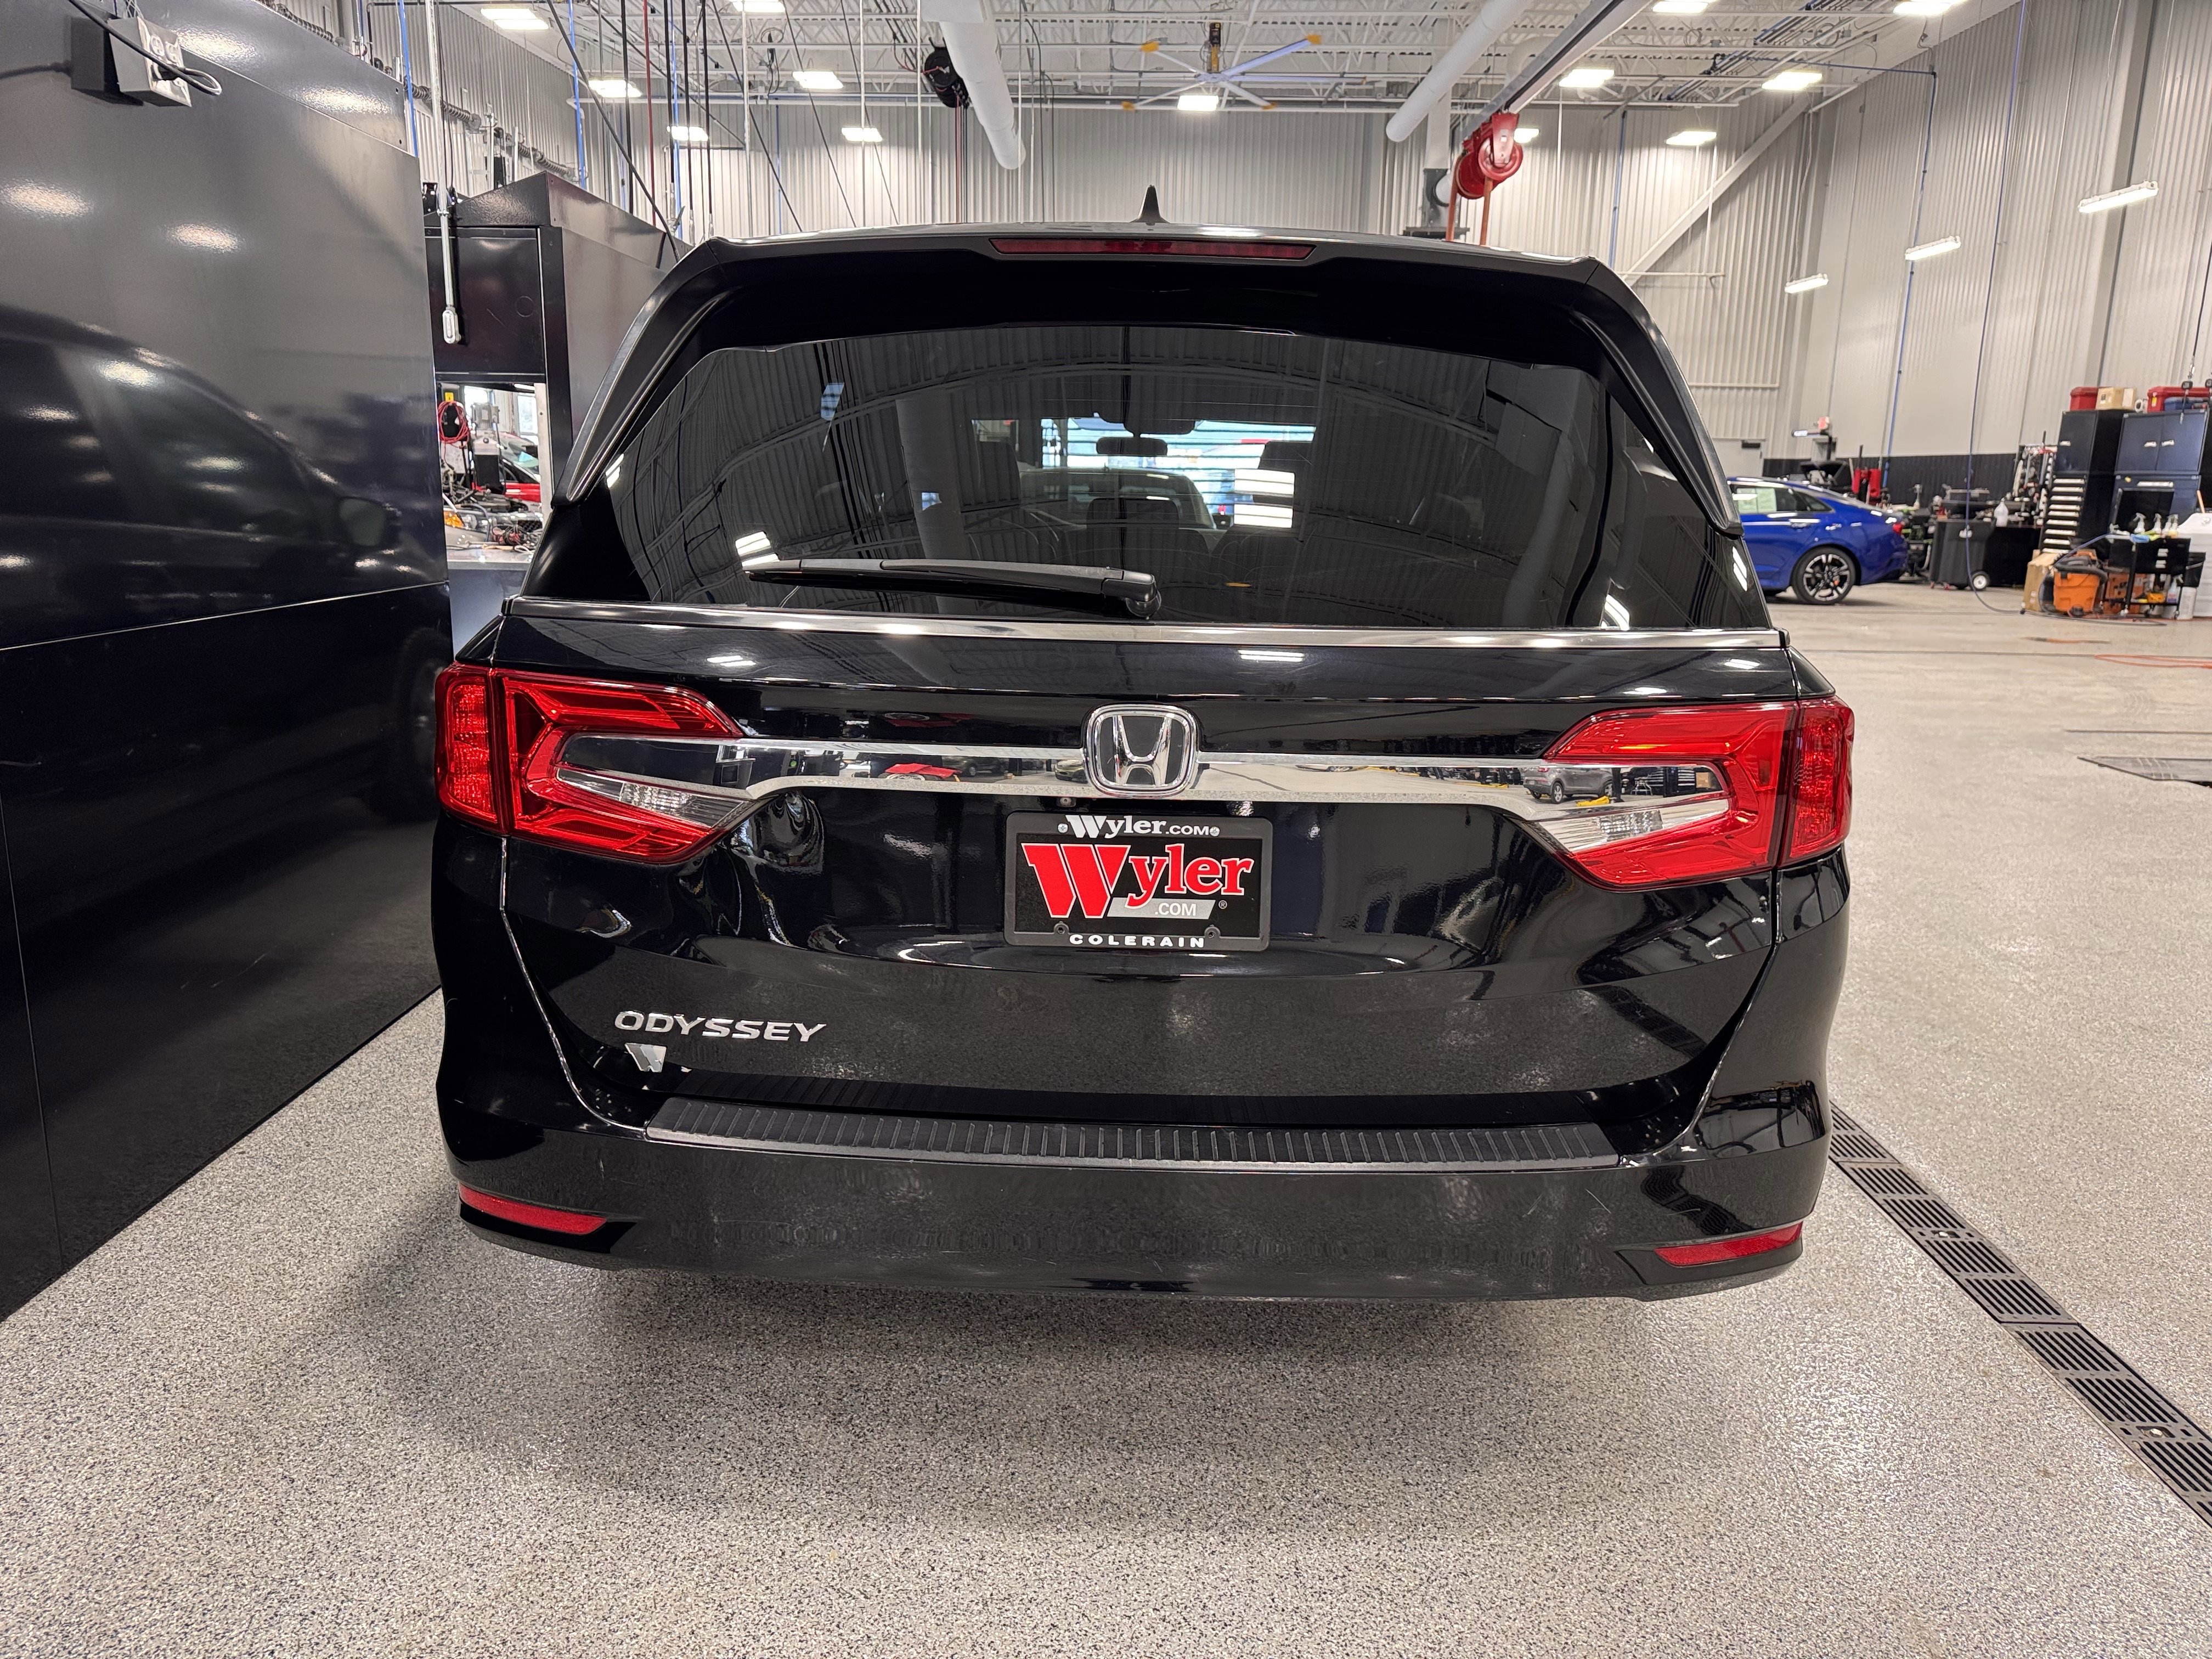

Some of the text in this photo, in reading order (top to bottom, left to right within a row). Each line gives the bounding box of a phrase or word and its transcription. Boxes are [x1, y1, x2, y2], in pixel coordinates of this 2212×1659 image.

[1065, 815, 1210, 839] Wyler.COM
[1021, 842, 1255, 919] Wyler
[1154, 902, 1197, 917] .COM
[1069, 934, 1204, 949] COLERAIN
[614, 1010, 827, 1042] ODYSSEY
